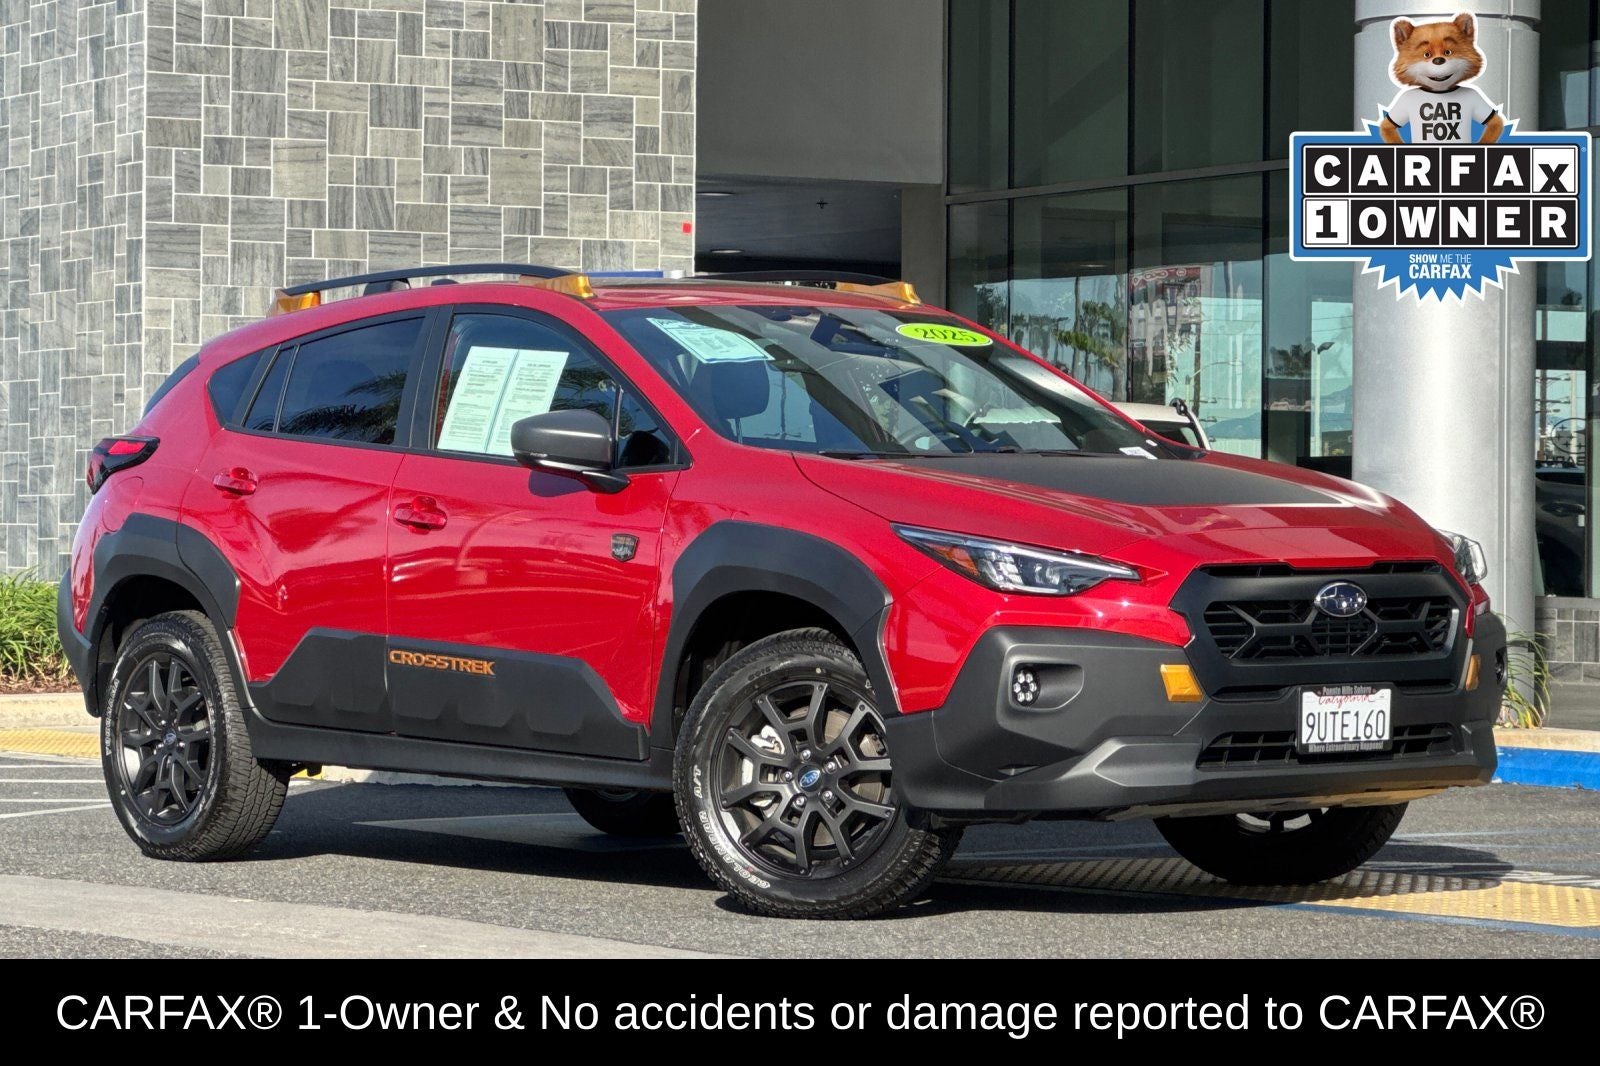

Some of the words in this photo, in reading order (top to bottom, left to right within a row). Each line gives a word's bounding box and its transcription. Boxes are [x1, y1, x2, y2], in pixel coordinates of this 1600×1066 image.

[914, 326, 978, 344] 2025
[389, 649, 496, 676] CROSSTREK
[1306, 710, 1385, 742] 9UTE160
[698, 810, 770, 889] GEOLANDAR
